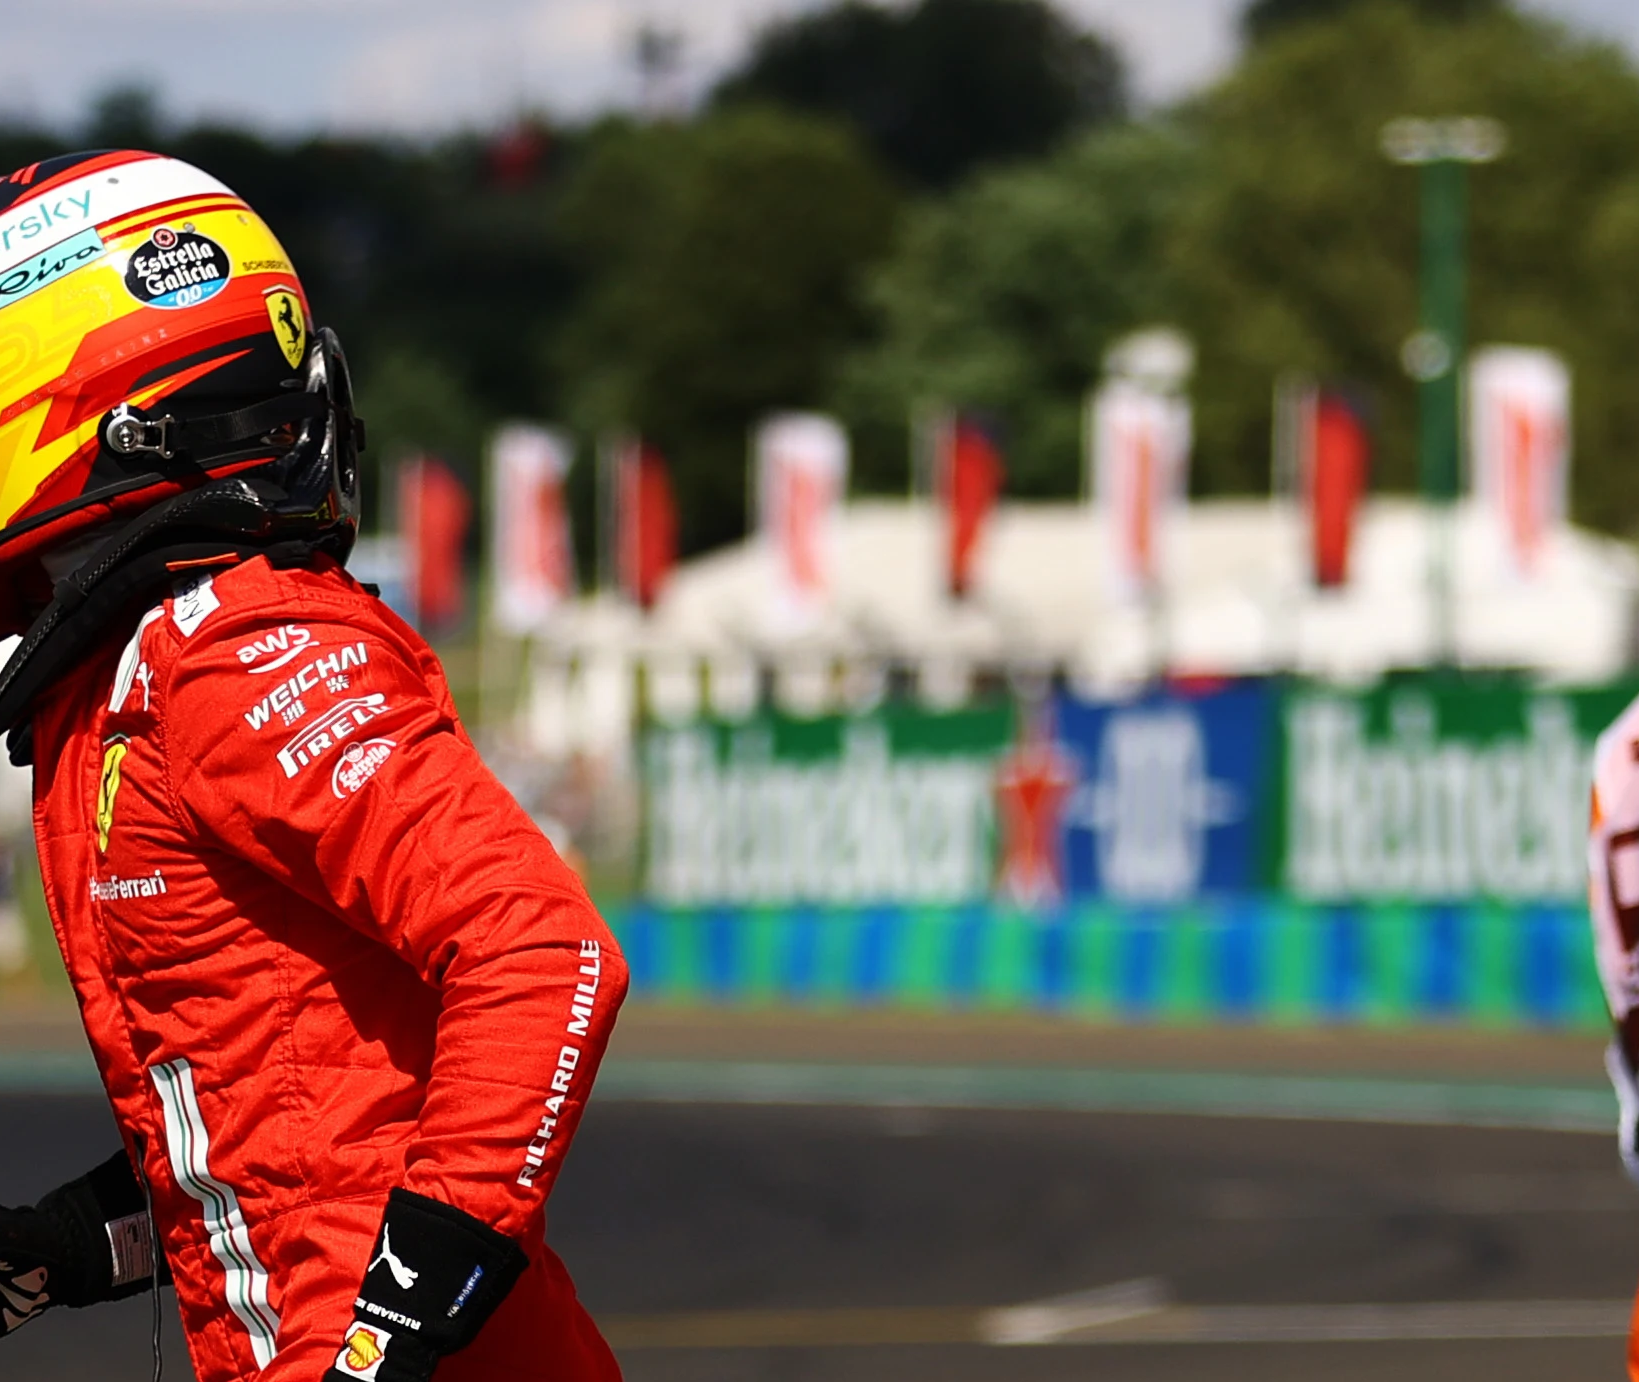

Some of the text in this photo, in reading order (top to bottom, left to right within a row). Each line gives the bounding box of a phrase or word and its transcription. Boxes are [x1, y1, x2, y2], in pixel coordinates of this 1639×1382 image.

[133, 241, 215, 278] Estrella
[145, 260, 220, 296] Galicia
[99, 327, 169, 367] SAINZ
[236, 624, 311, 665] aws
[244, 642, 368, 731] WEICHAI
[338, 745, 391, 788] Estrella
[516, 938, 601, 1188] RICHARD MILLE
[366, 1302, 422, 1331] RICHARD
